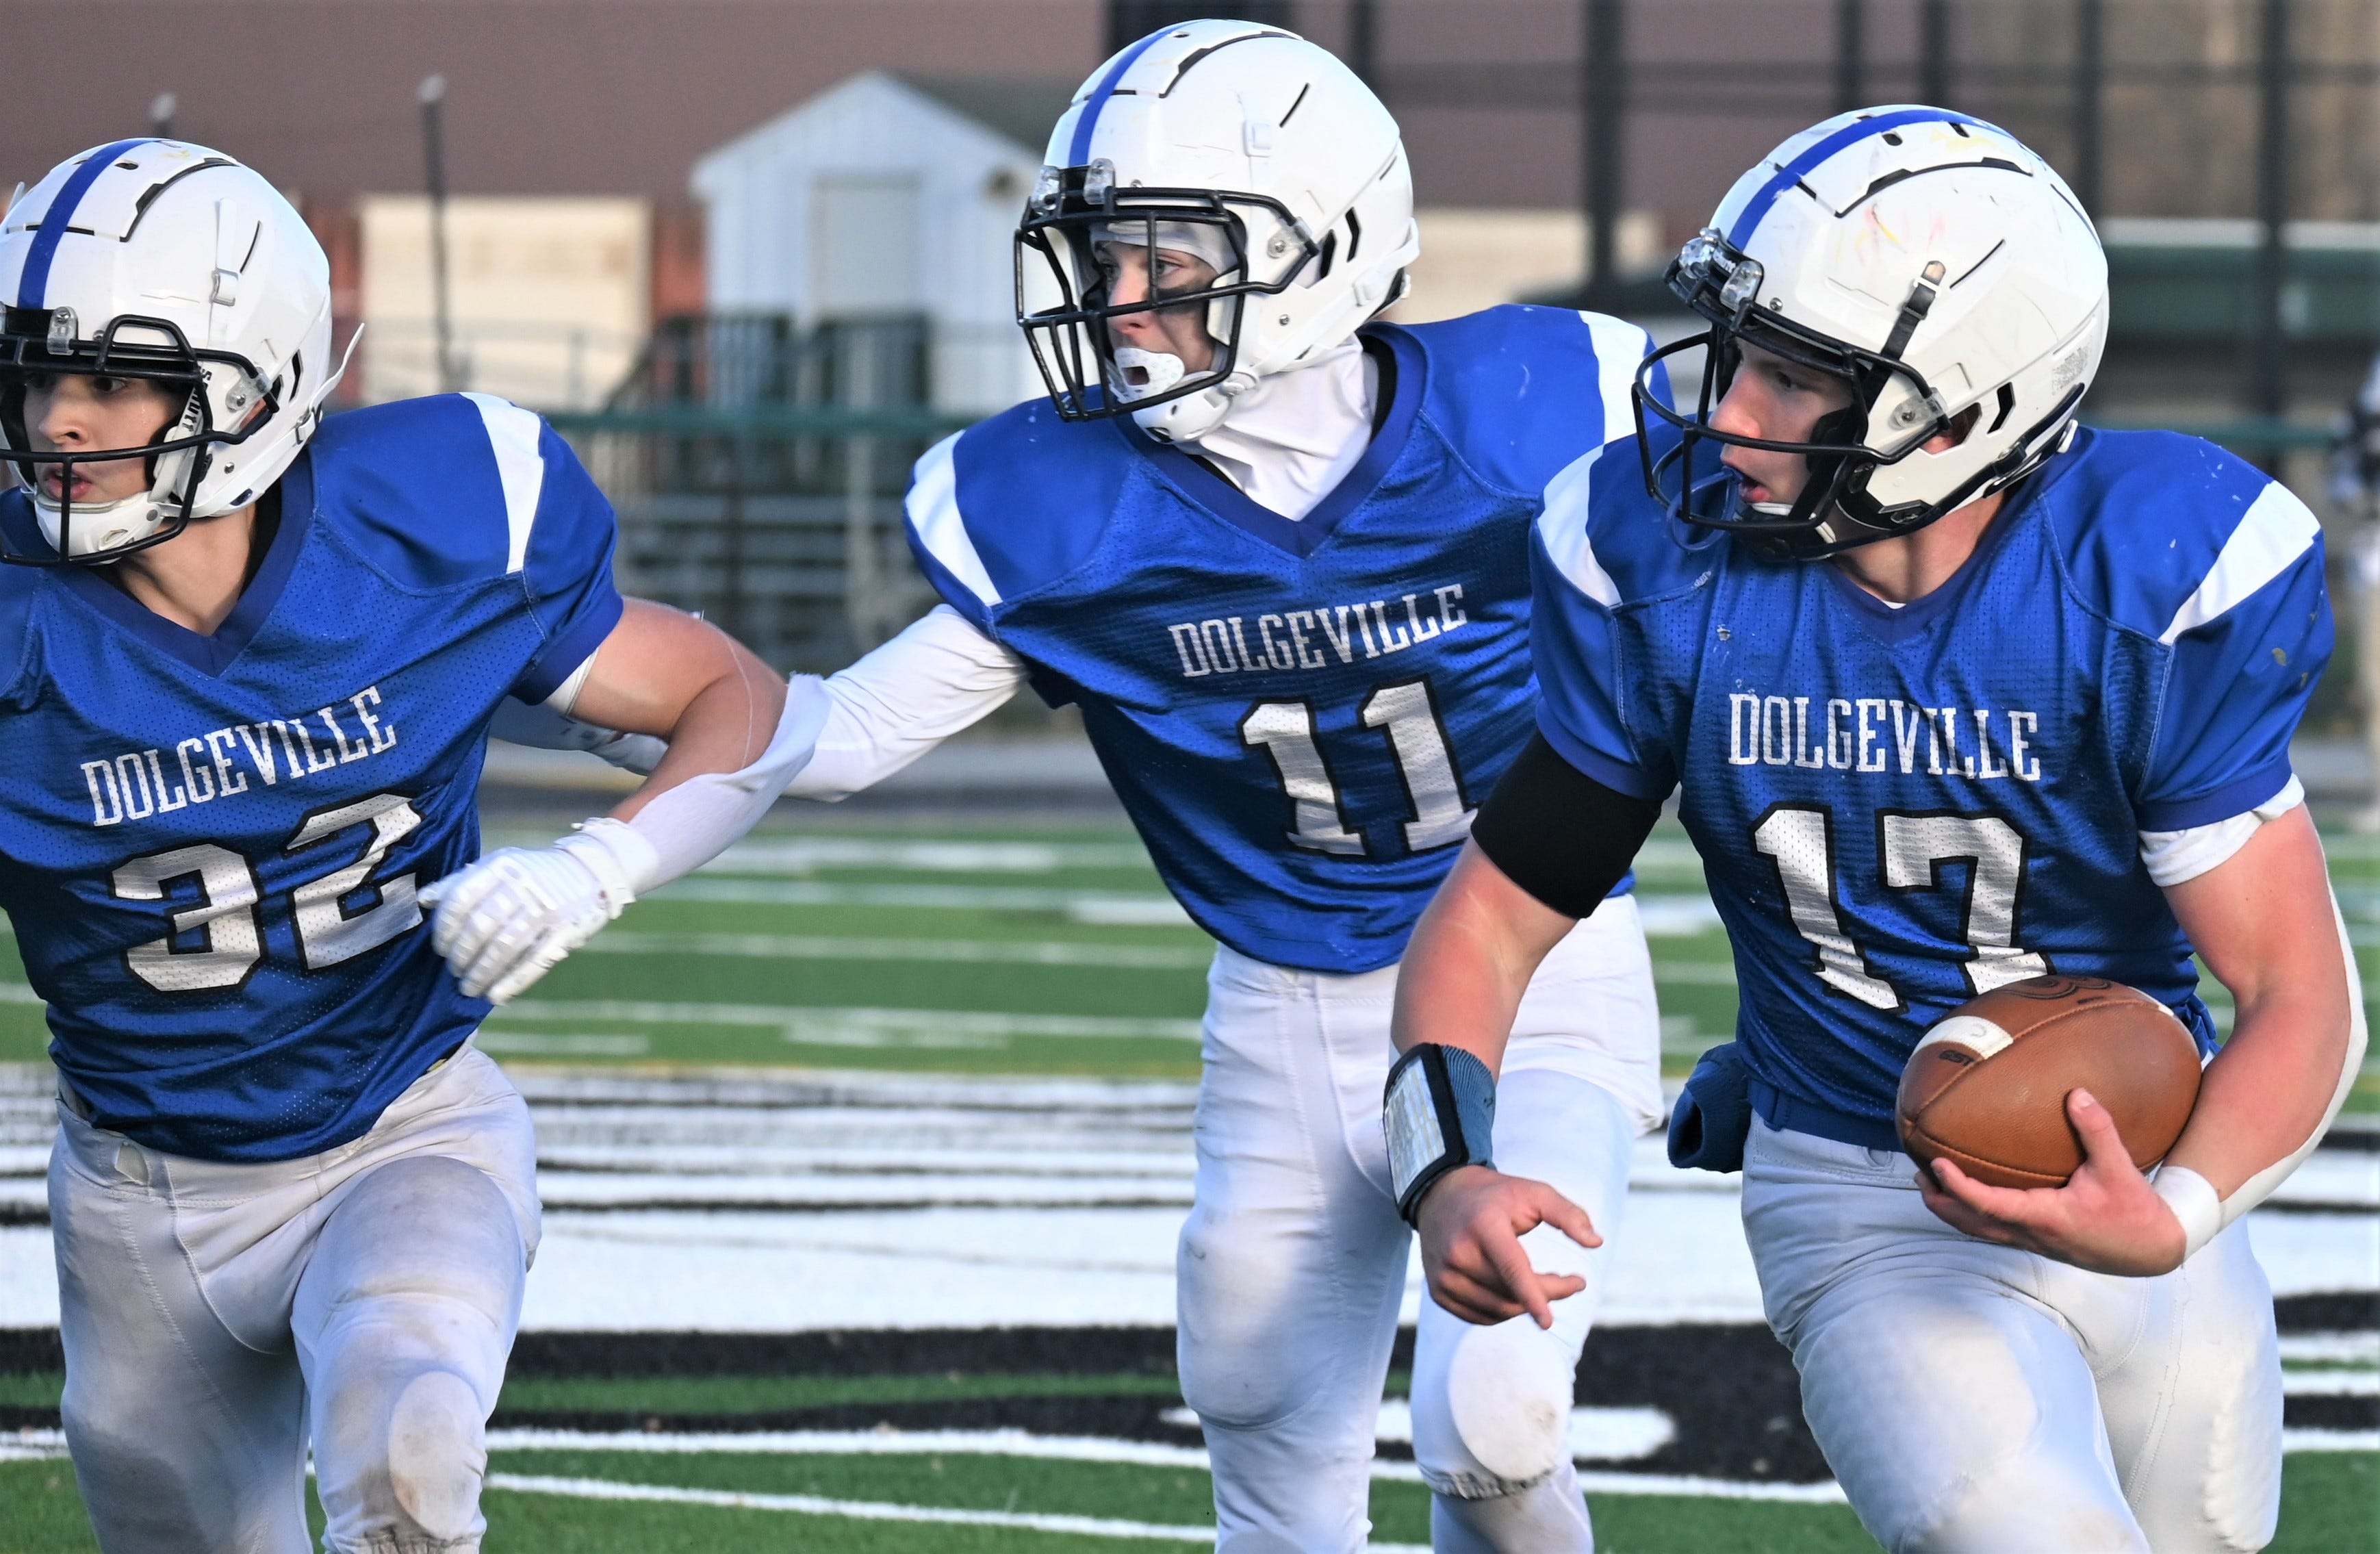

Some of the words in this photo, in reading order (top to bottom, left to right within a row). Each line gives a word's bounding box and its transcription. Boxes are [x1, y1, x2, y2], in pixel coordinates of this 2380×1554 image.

[182, 368, 212, 432] SUTT
[1168, 583, 1467, 677] DOLGEVILLE
[81, 686, 396, 827] DOLGEVILLE
[1238, 675, 1479, 858] 11
[1728, 693, 2041, 781] DOLGEVILLE
[111, 793, 424, 994] 32
[1751, 804, 2052, 1013] 17
